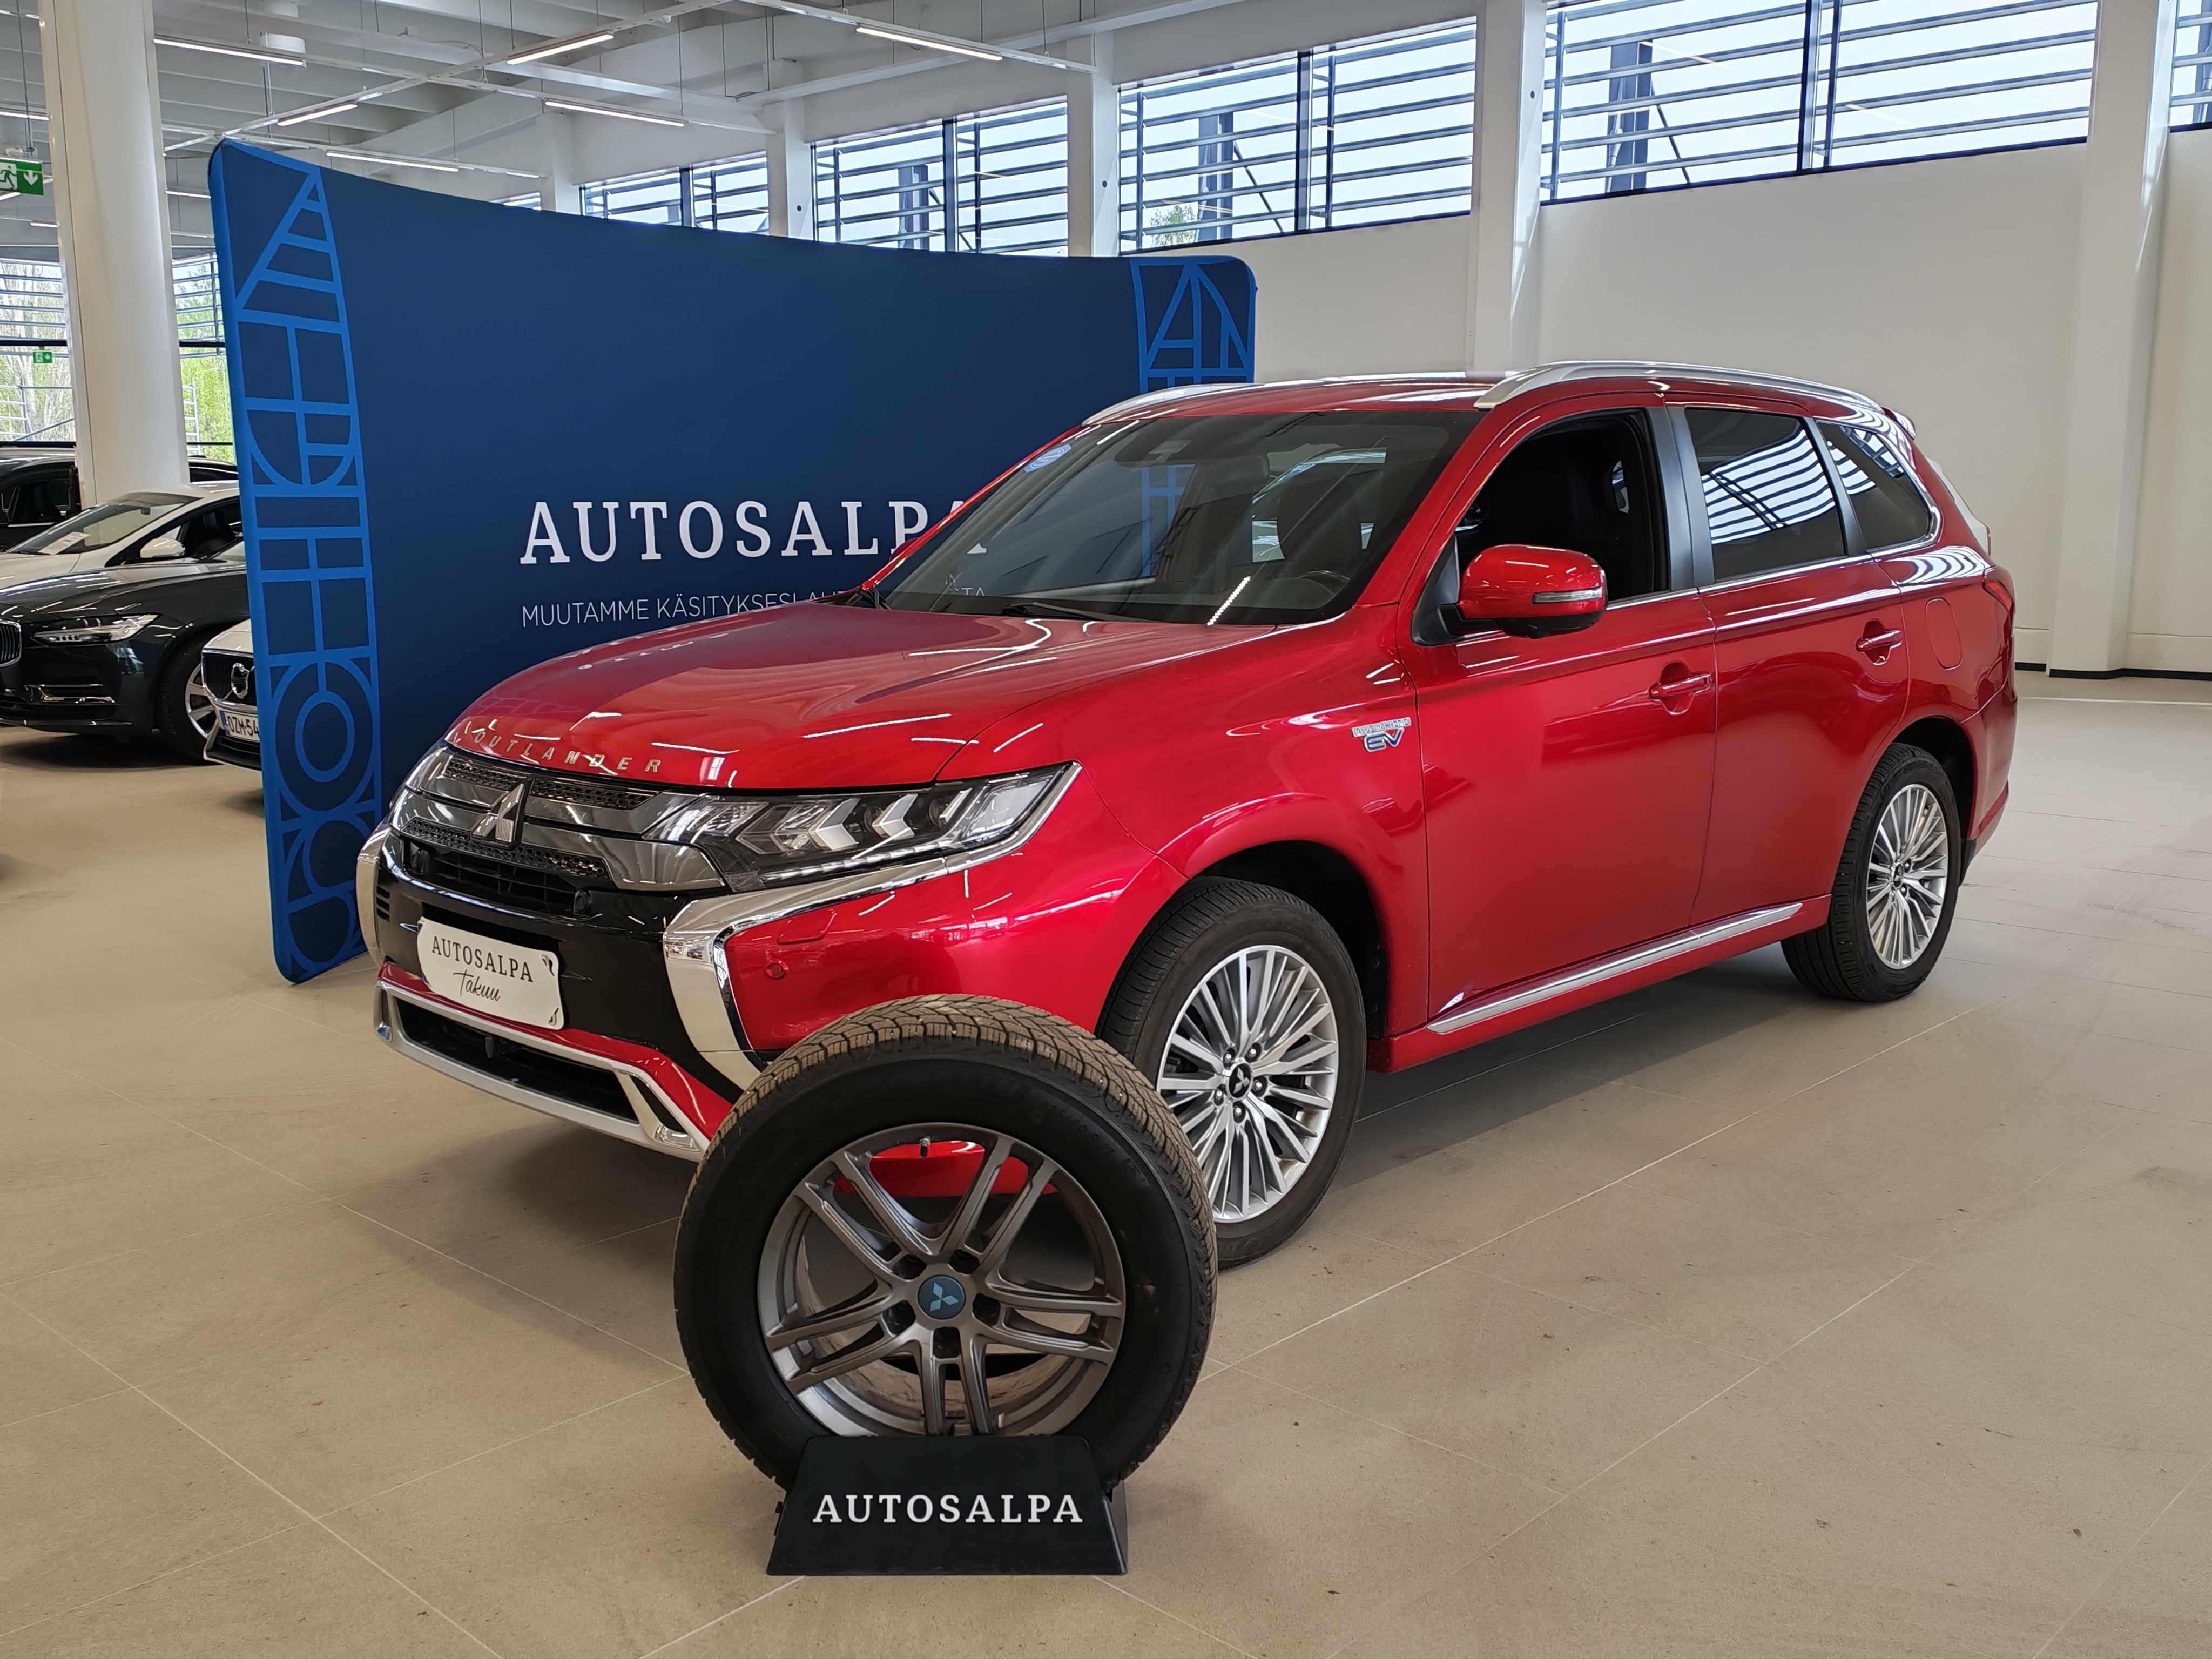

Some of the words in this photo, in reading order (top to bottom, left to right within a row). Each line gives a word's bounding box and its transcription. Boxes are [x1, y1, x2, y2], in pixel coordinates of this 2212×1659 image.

[520, 501, 987, 564] AUTOSALP
[523, 599, 649, 627] MUUTAMME
[474, 732, 660, 773] OUTLANDER
[1364, 727, 1405, 752] EV
[432, 935, 534, 982] AUTOSALPA
[453, 969, 501, 1002] Takuu
[813, 1494, 1083, 1523] AUTOSALPA
